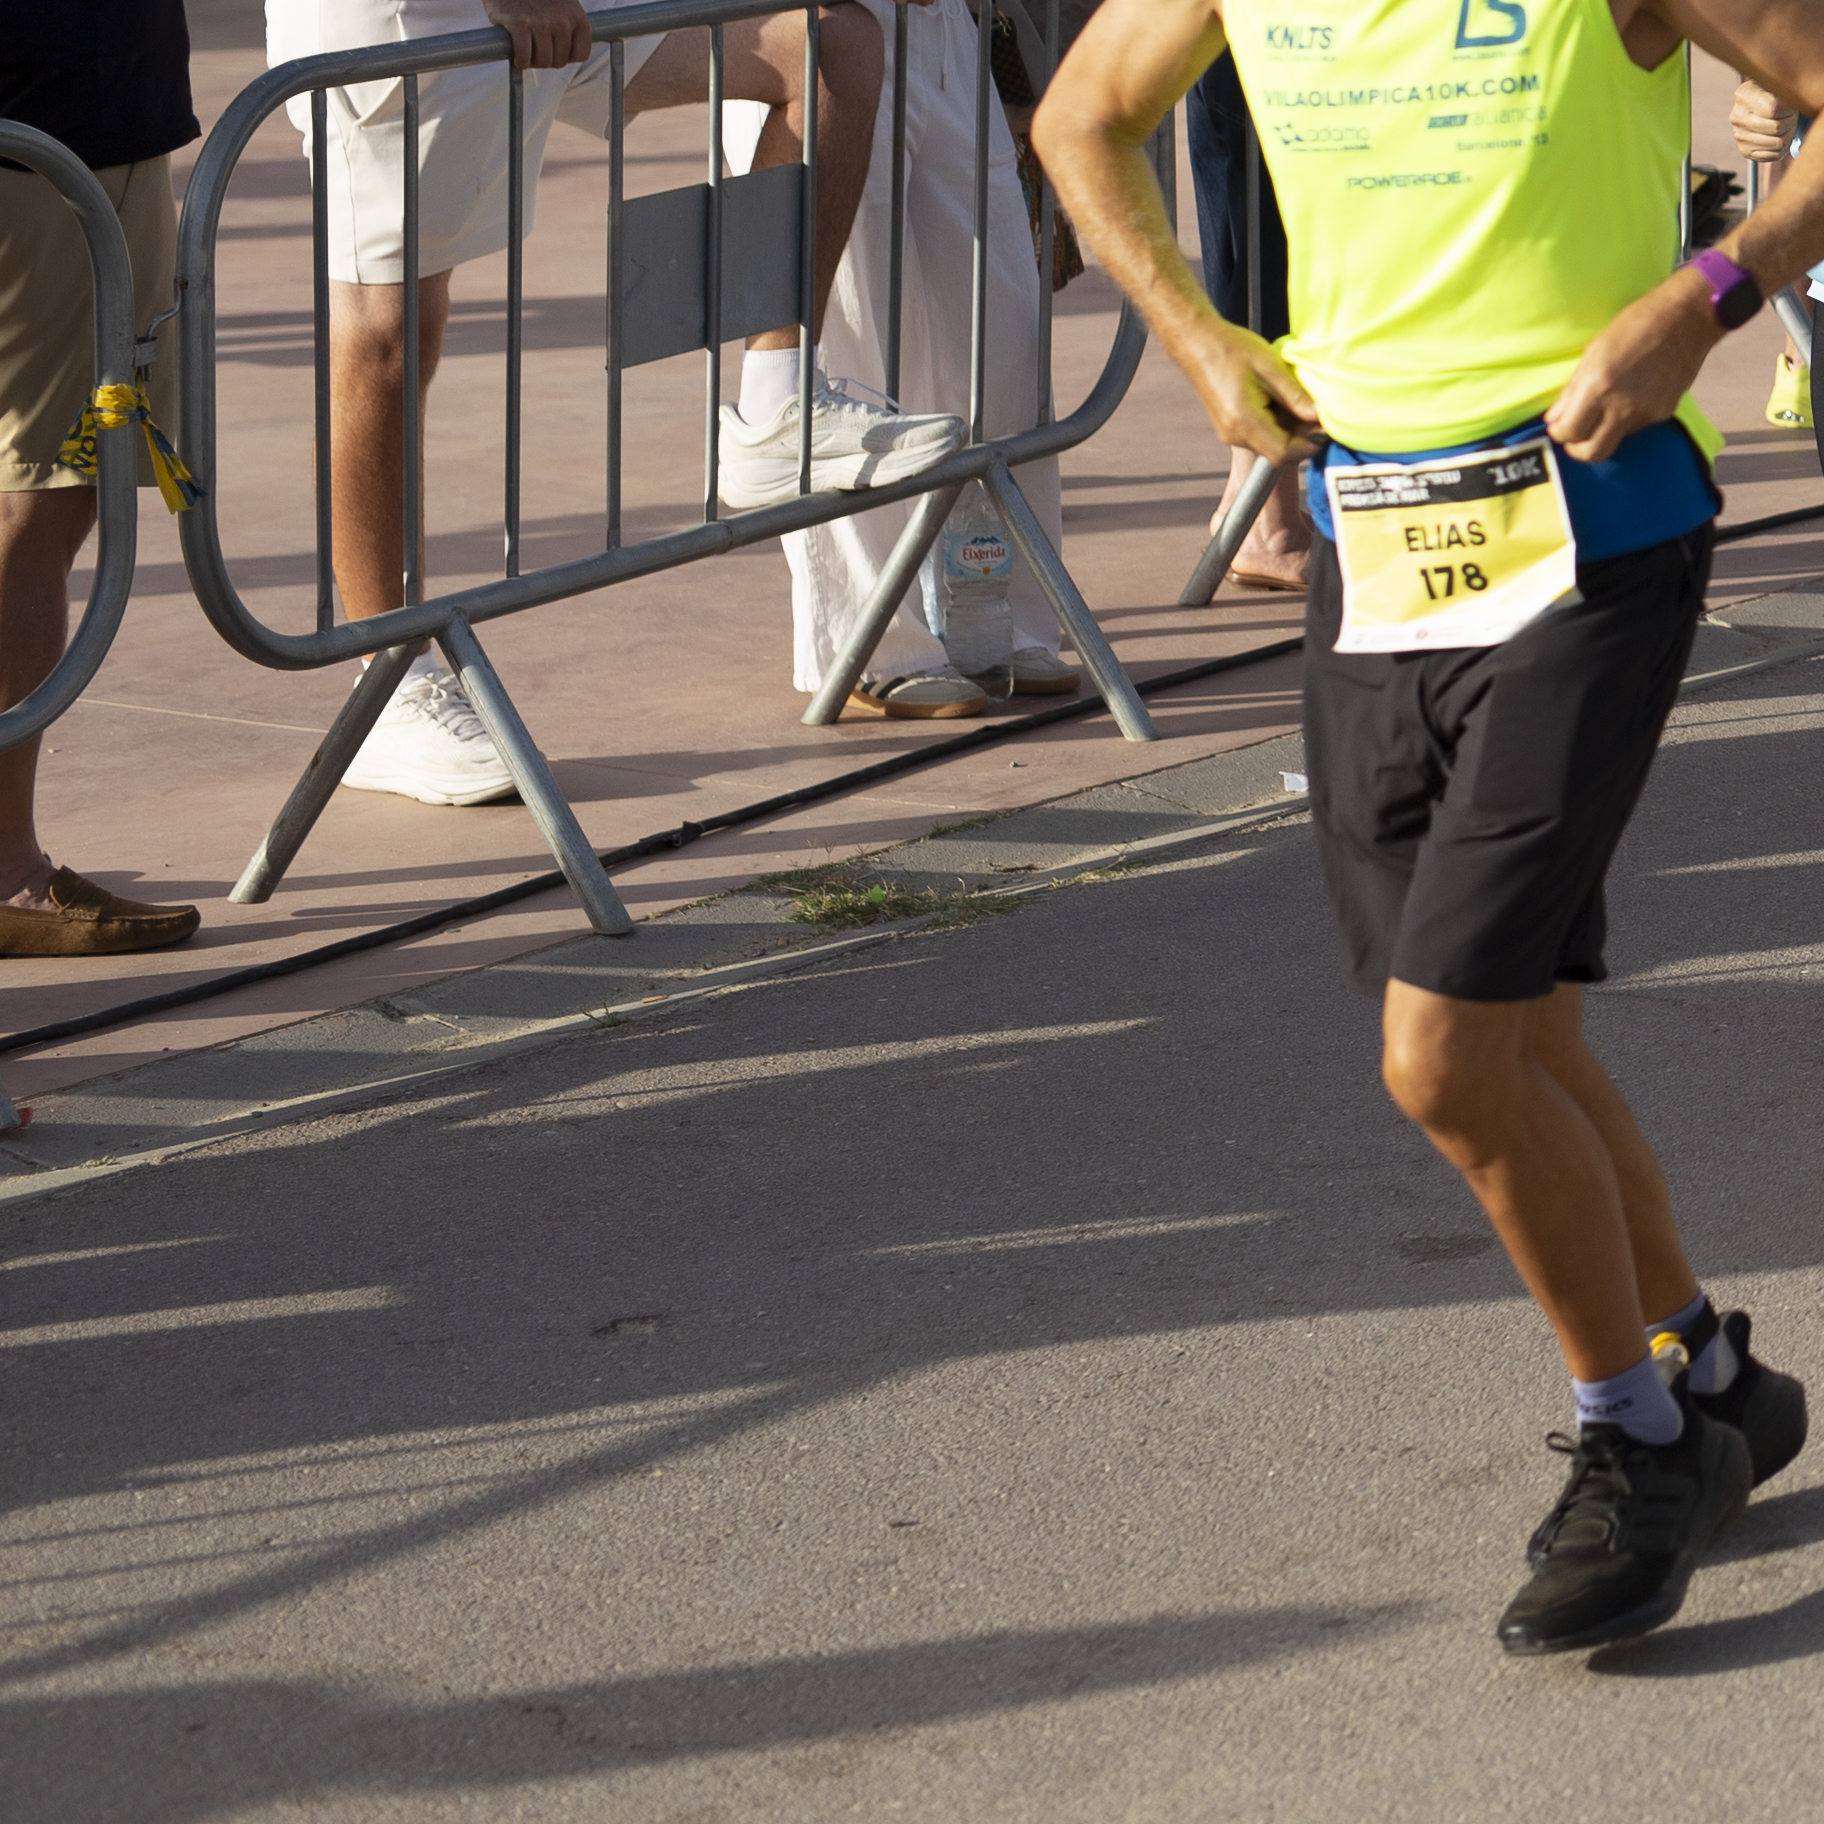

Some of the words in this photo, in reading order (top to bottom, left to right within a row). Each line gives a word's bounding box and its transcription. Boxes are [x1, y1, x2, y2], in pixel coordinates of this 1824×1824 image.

[1490, 455, 1542, 487] 10K
[1404, 520, 1488, 553] ELIAS
[1419, 562, 1489, 601] 178
